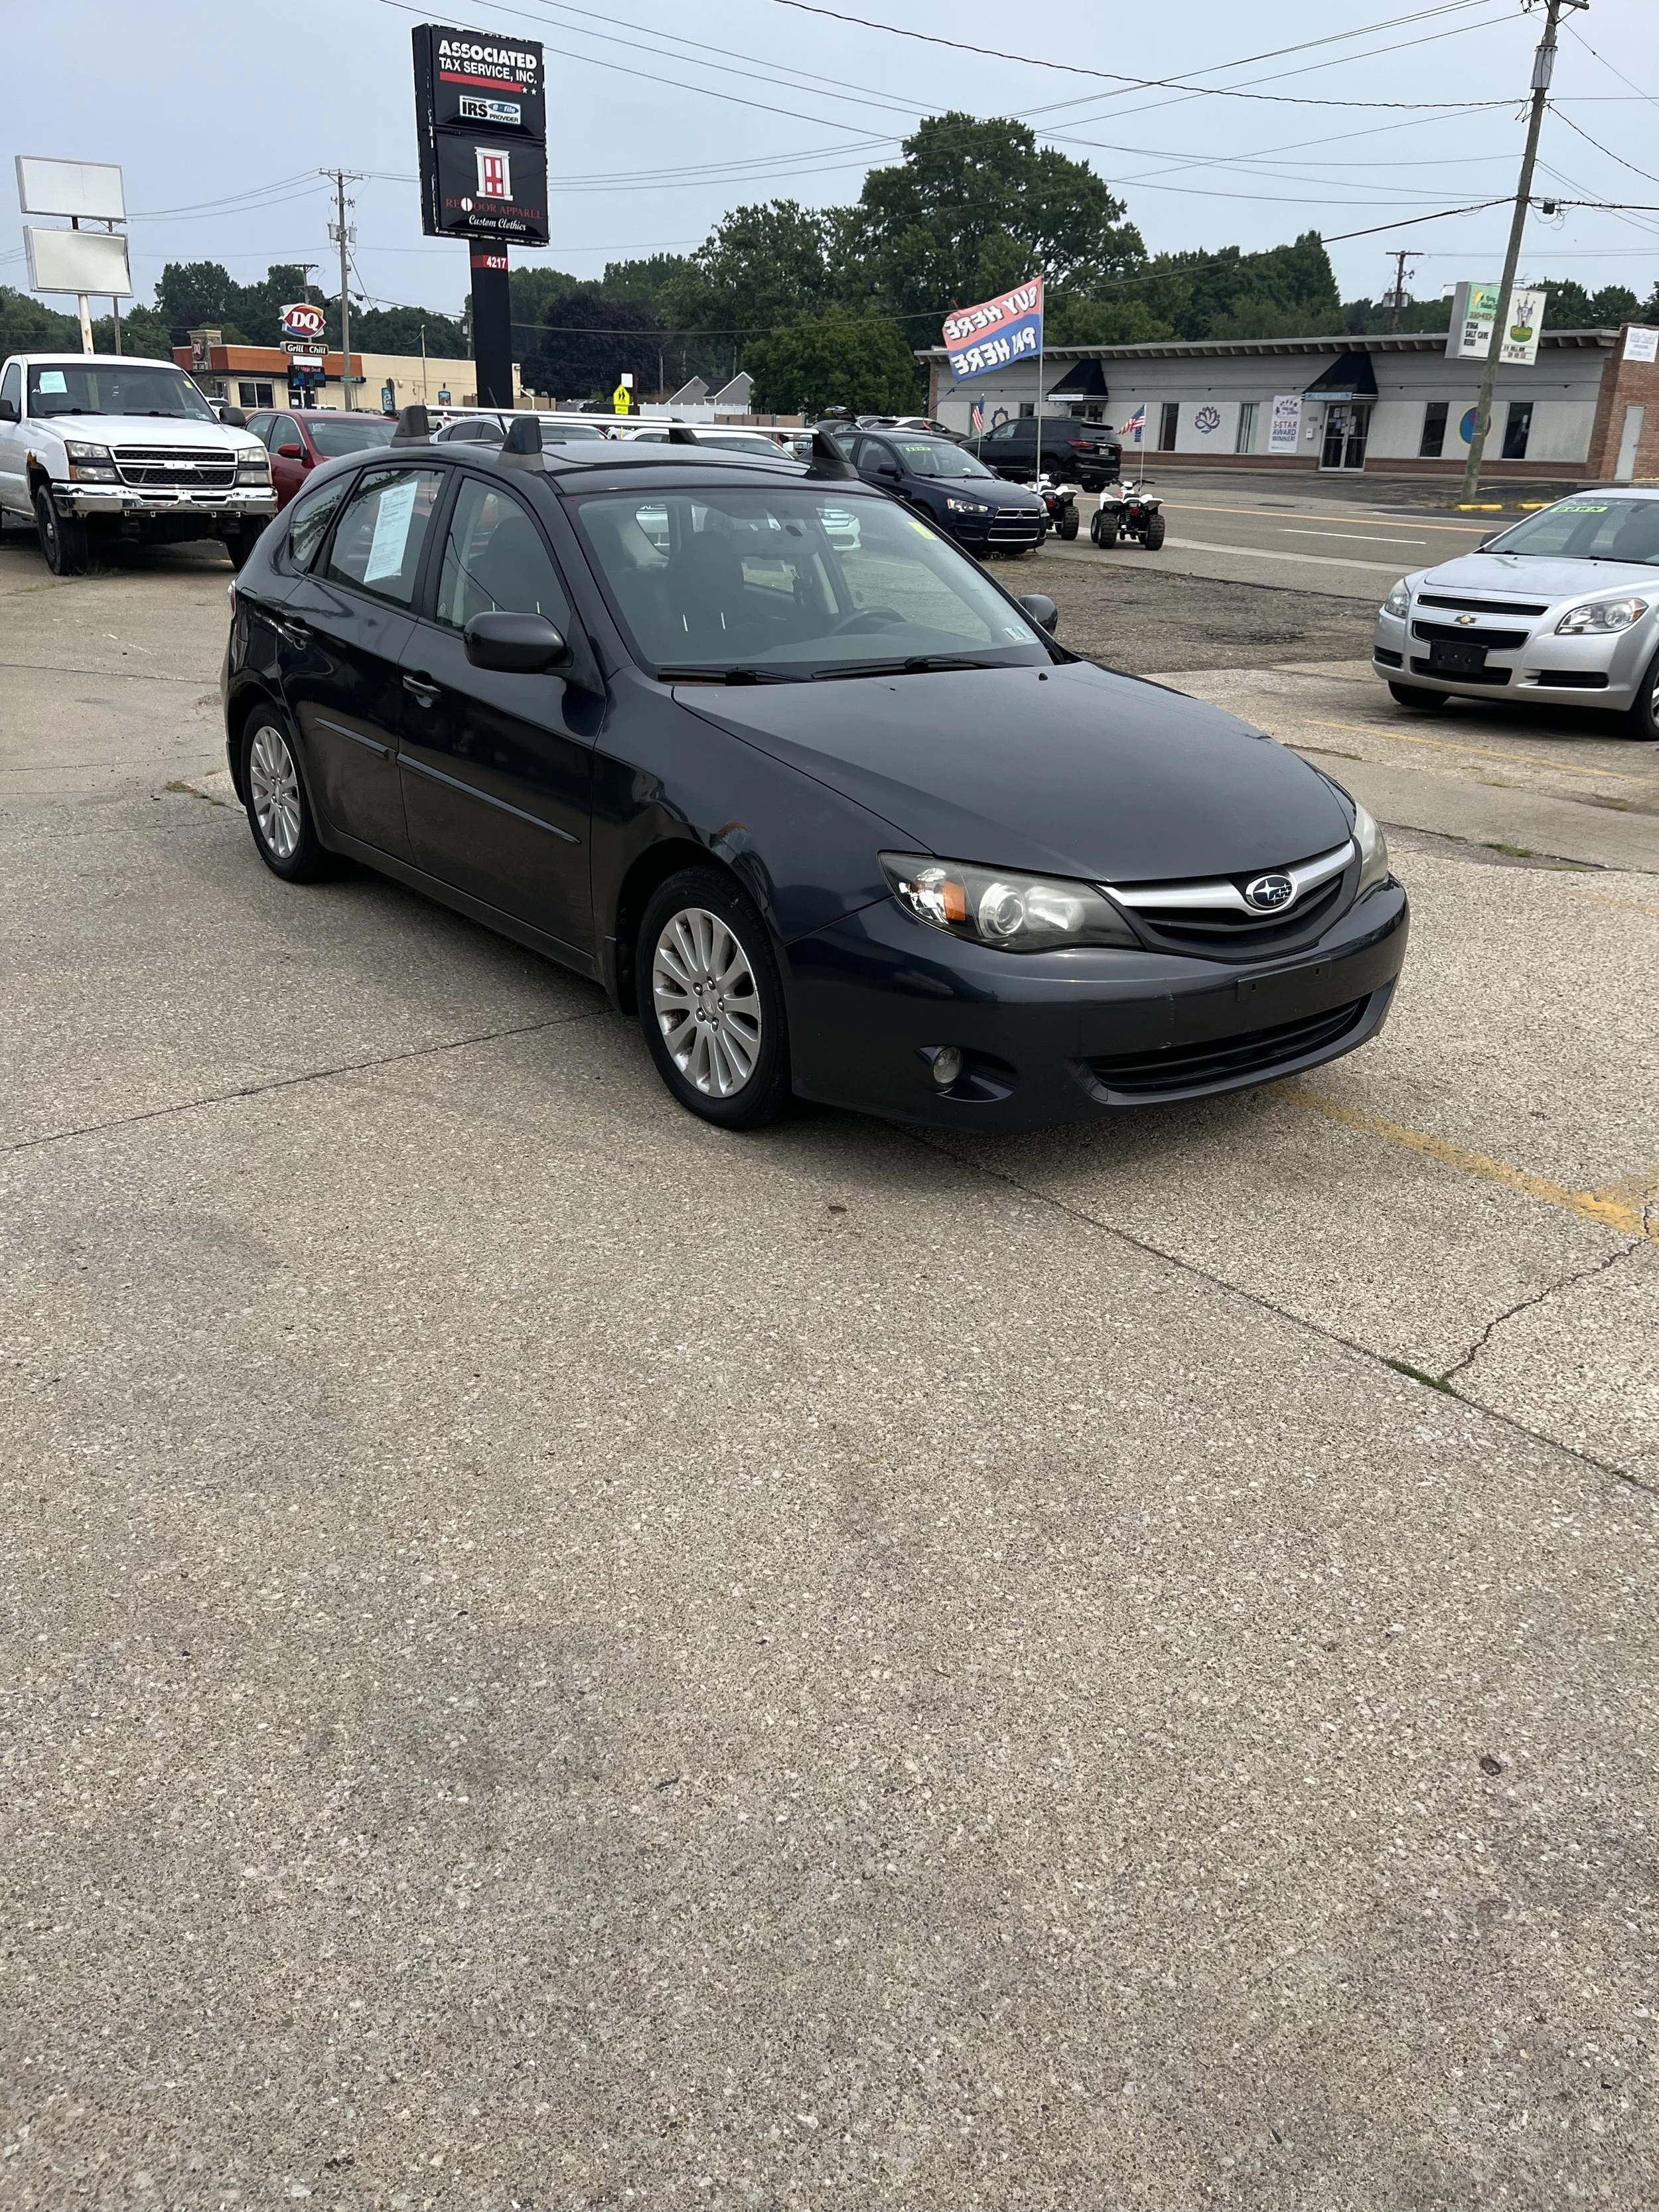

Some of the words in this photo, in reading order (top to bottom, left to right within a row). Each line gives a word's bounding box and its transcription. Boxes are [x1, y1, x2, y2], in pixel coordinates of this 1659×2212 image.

[439, 39, 537, 69] ASSOCIATED
[439, 57, 461, 72] TAX
[463, 61, 513, 82] SERVICE,
[516, 69, 538, 84] INC.
[462, 101, 488, 117] IRS
[490, 113, 518, 123] PROVIDER
[499, 206, 541, 220] APPAREL
[469, 214, 496, 228] Custom
[498, 218, 526, 232] Clothier
[486, 256, 506, 269] 4217
[291, 311, 319, 331] DQ
[309, 346, 326, 354] Chill
